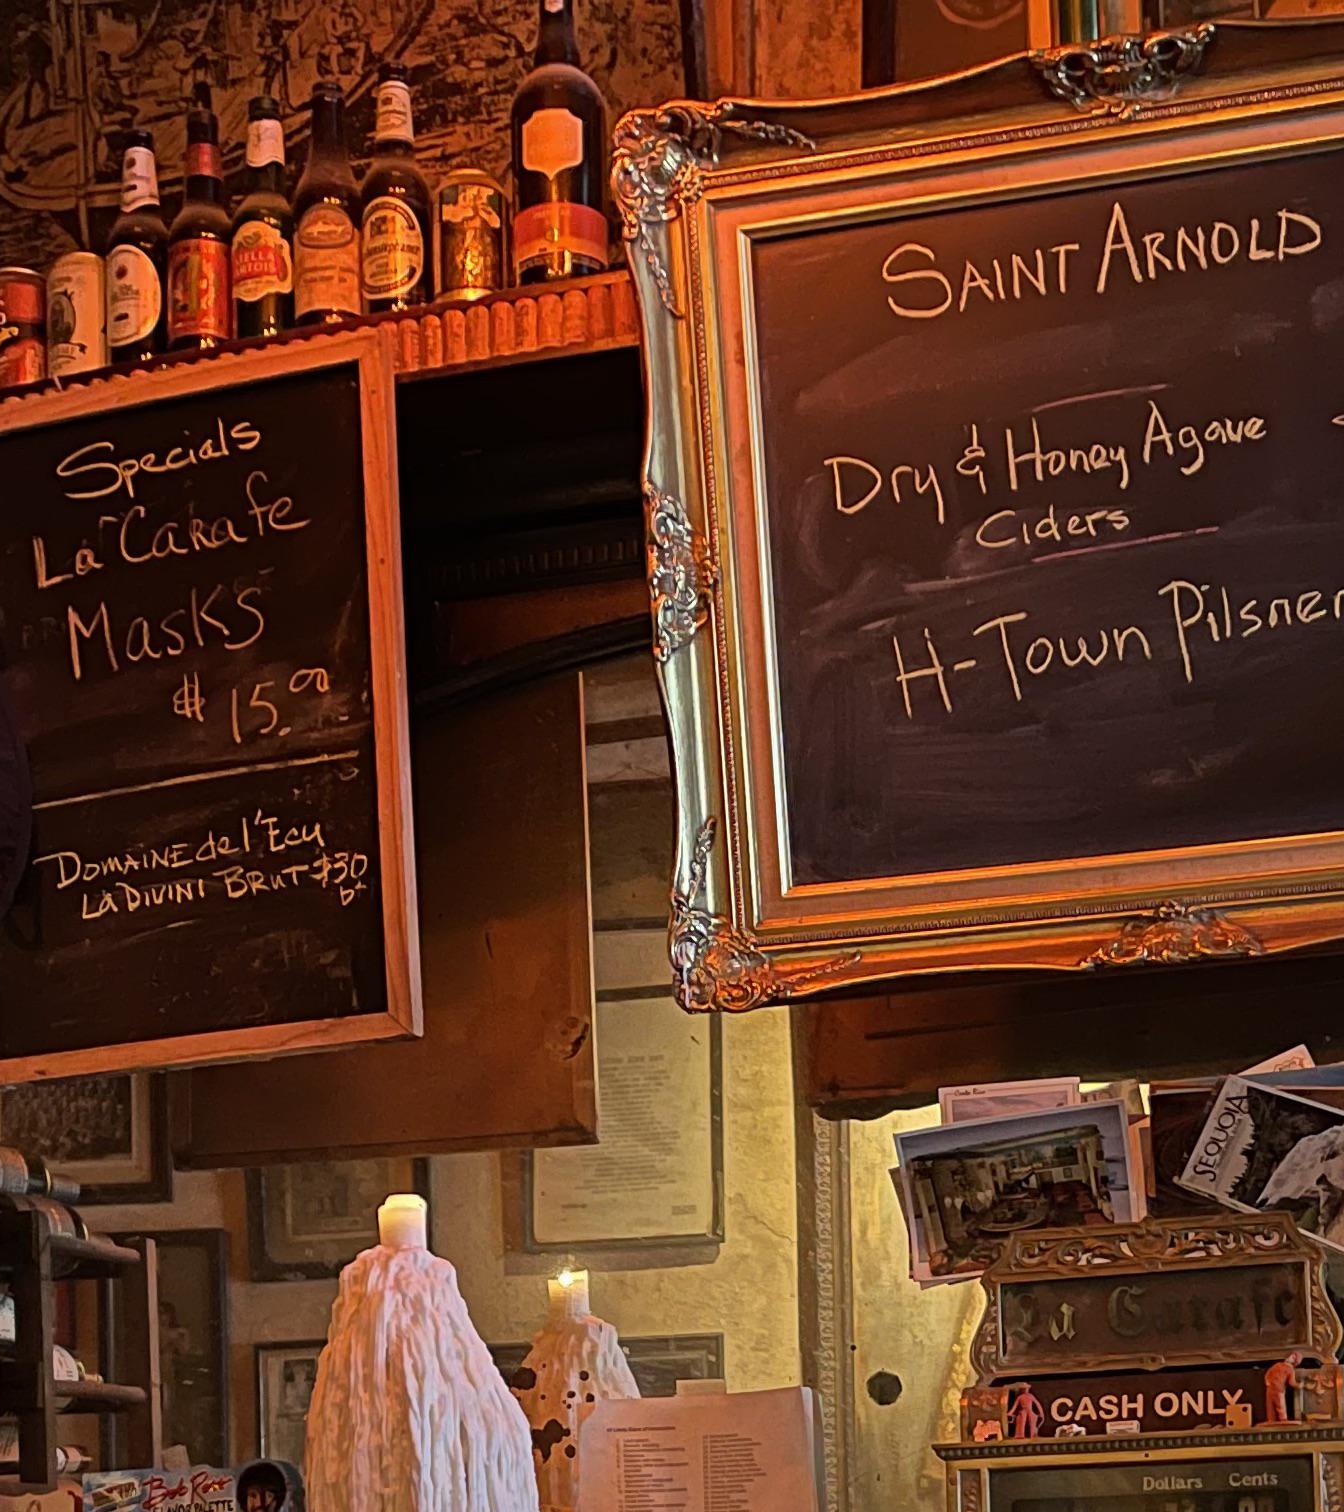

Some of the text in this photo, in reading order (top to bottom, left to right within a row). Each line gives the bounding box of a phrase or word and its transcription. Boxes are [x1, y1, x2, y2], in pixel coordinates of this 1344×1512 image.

[882, 202, 1322, 318] SAINT ARNOLD
[57, 418, 261, 501] Specials
[825, 454, 945, 522] Dry
[957, 424, 986, 495] &
[1006, 417, 1129, 493] Honey
[1142, 402, 1267, 475] Agave
[975, 507, 1131, 550] Ciders
[34, 535, 103, 589] La
[66, 586, 266, 680] Masks
[892, 611, 1152, 720] H-Town
[173, 676, 204, 722] $
[34, 842, 190, 890] DOMAINE
[195, 834, 235, 861] de
[1193, 1093, 1250, 1183] SEQUOIA
[1050, 1388, 1244, 1422] CASH ONLY
[143, 1470, 232, 1509] Bob Ross
[1143, 1471, 1278, 1491] Dollars Cents
